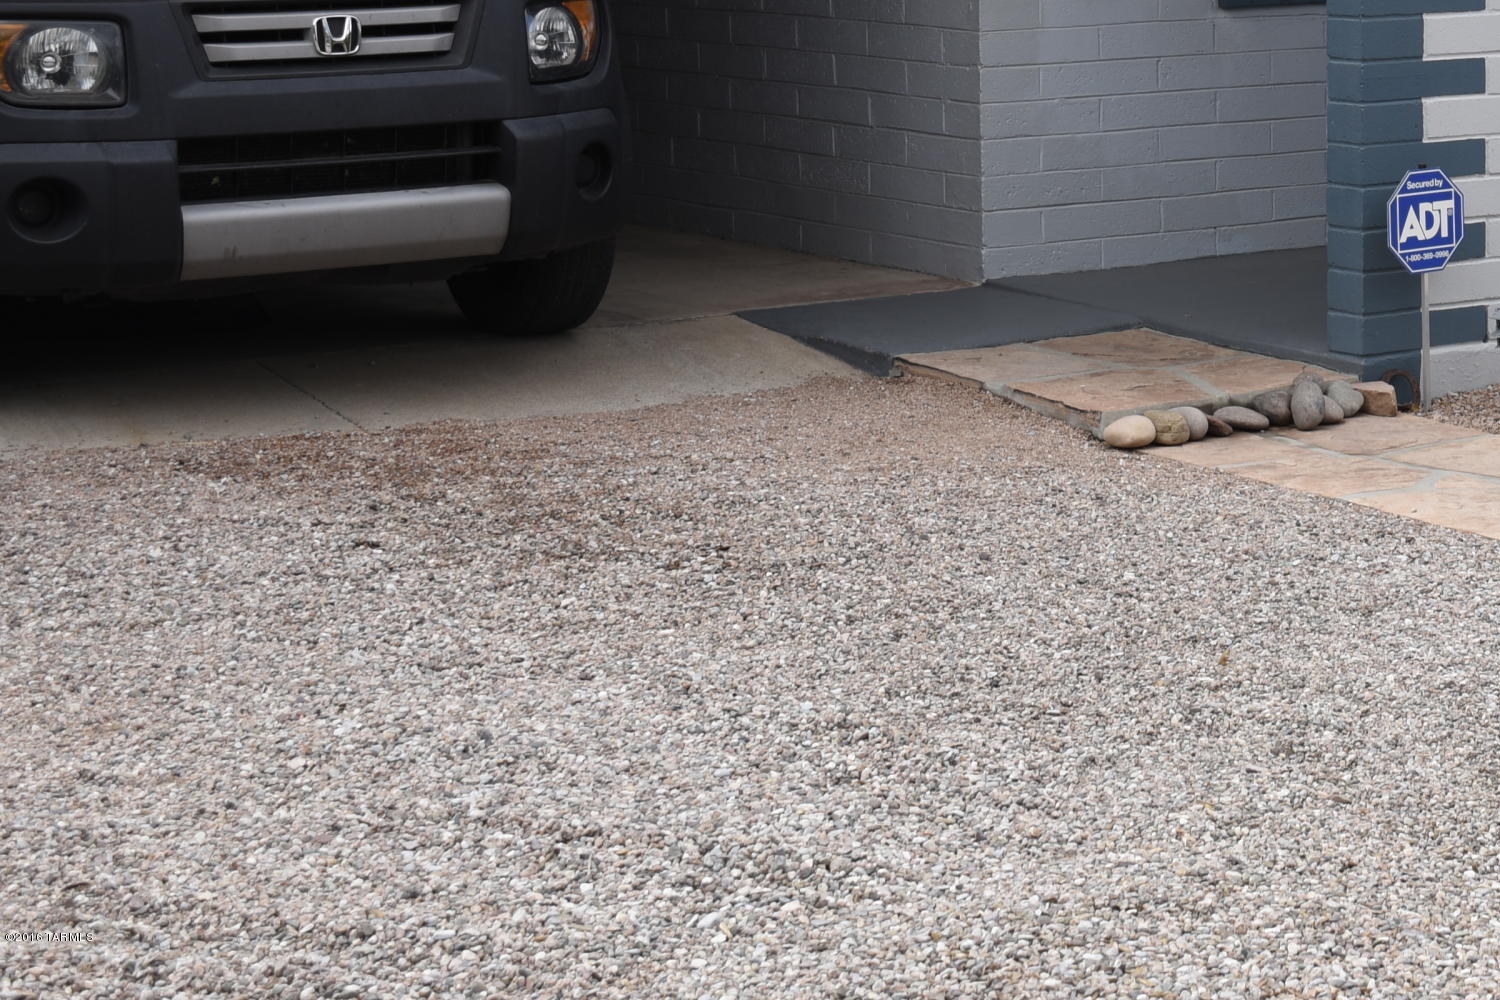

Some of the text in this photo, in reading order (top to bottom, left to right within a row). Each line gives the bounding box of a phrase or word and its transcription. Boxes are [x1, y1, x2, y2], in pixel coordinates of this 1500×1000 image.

[1407, 178, 1444, 190] Secured by
[1400, 200, 1454, 243] ADT
